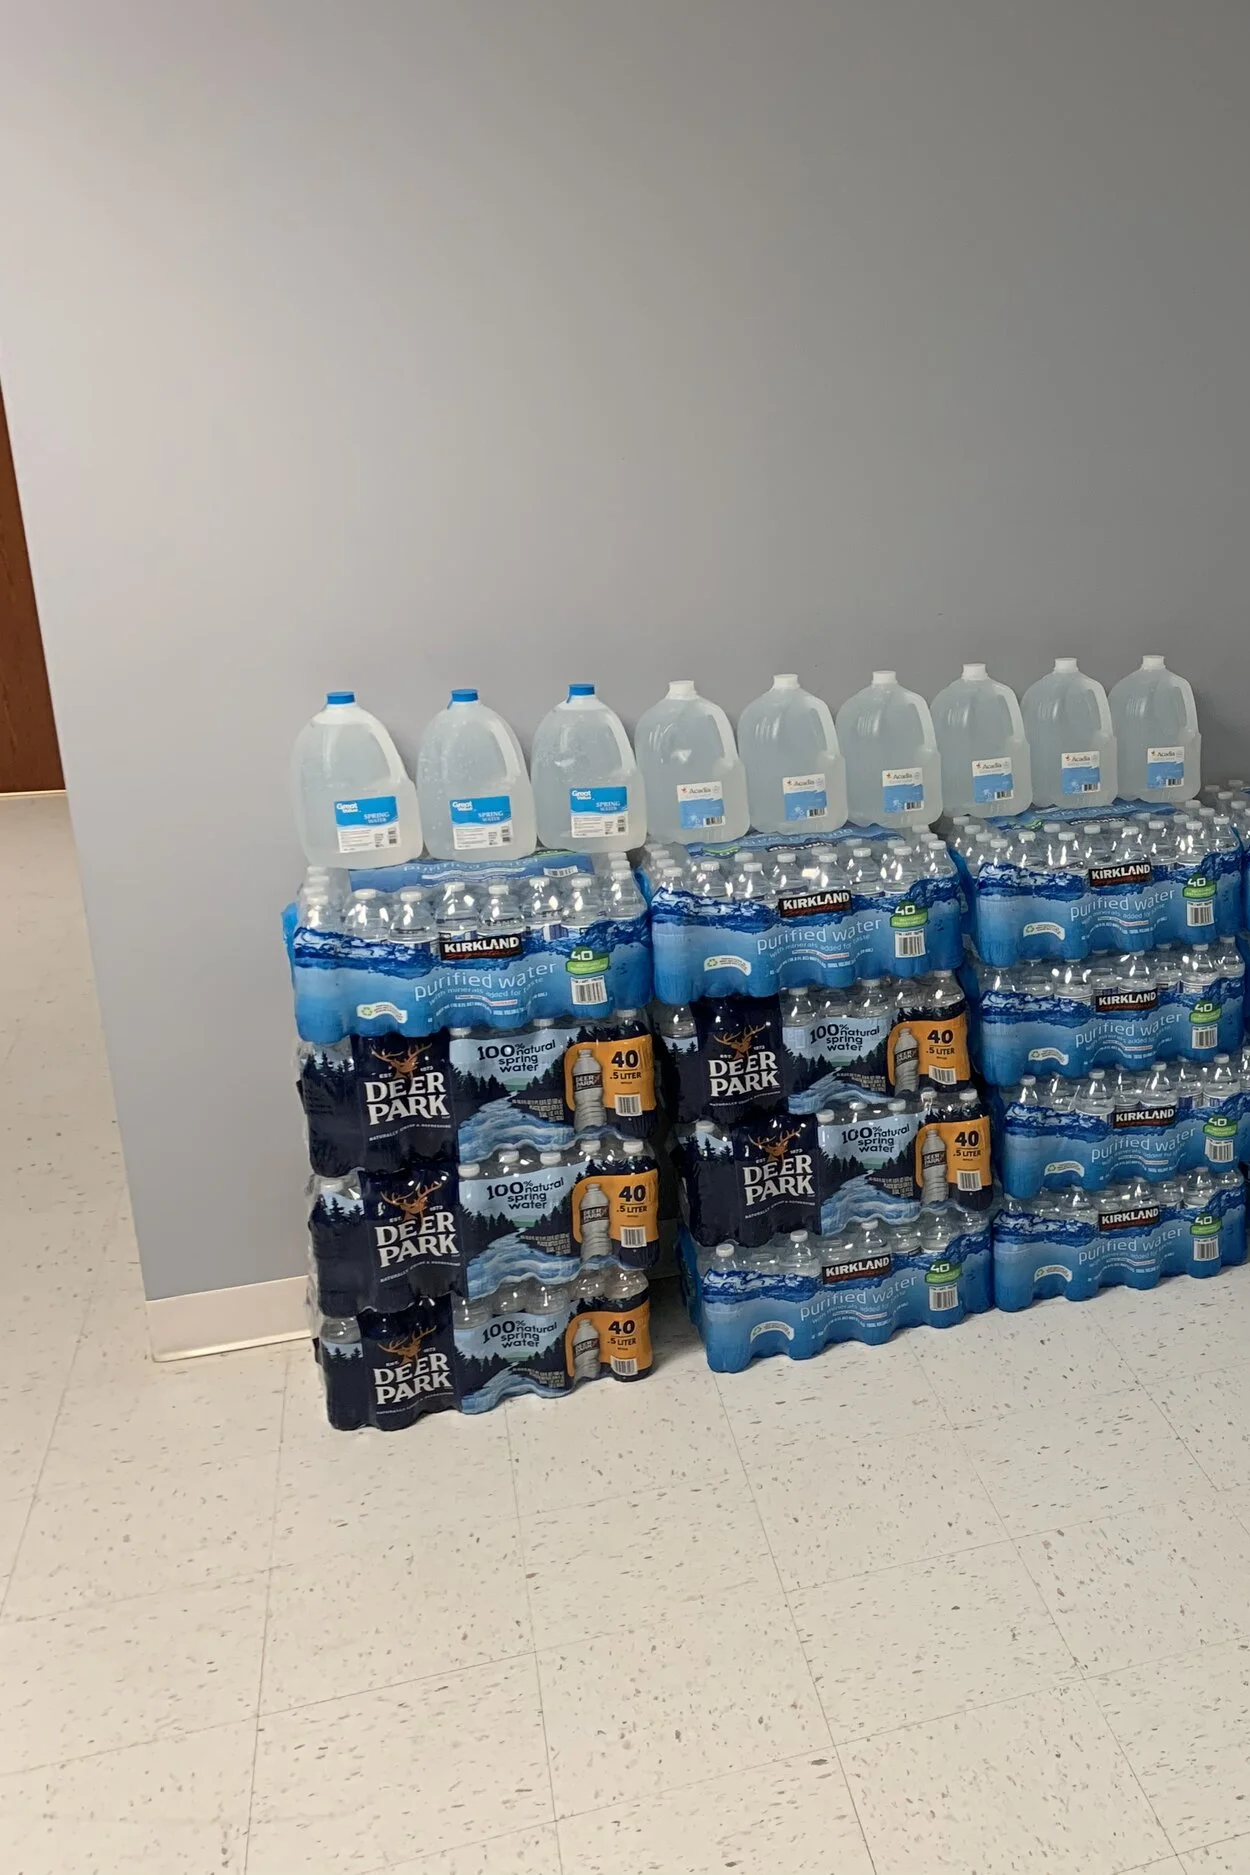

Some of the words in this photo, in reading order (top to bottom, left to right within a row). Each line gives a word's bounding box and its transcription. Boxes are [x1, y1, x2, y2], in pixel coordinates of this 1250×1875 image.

[571, 790, 592, 798] Great
[689, 786, 711, 794] Acadia
[336, 802, 358, 811] Great
[452, 801, 473, 809] Great
[595, 800, 621, 808] SPRING
[363, 811, 390, 820] SPRING
[478, 810, 504, 818] SPRING
[1092, 864, 1150, 879] KIRKLAND
[1188, 878, 1205, 887] 40
[783, 892, 849, 910] KIRKLAND
[1071, 896, 1129, 921] purified
[1134, 889, 1174, 911] water
[895, 905, 914, 915] 40
[444, 937, 519, 953] KIRKLAND
[757, 928, 827, 955] purified
[832, 920, 881, 942] water
[571, 951, 593, 961] 40
[415, 972, 492, 1001] purified
[499, 963, 556, 988] water
[1099, 992, 1156, 1005] KIRKLAND
[1195, 1004, 1212, 1012] 40
[810, 1023, 849, 1044] 100%
[840, 1026, 880, 1037] natural
[928, 1030, 953, 1044] 40
[1076, 1024, 1134, 1047] purified
[1140, 1012, 1181, 1036] water
[826, 1035, 863, 1046] spring
[827, 1042, 863, 1051] water
[478, 1044, 524, 1061] 100%
[516, 1041, 555, 1056] natural
[498, 1054, 538, 1068] spring
[500, 1062, 538, 1072] water
[612, 1051, 638, 1068] 40
[708, 1050, 778, 1076] DEER
[621, 1071, 641, 1080] LITER
[710, 1070, 780, 1096] PARK
[364, 1072, 446, 1102] DEER
[367, 1094, 450, 1125] PARK
[1116, 1109, 1174, 1122] KIRKLAND
[1209, 1118, 1226, 1126] 40
[841, 1127, 882, 1143] 100%
[874, 1125, 910, 1137] natural
[858, 1136, 894, 1147] spring
[955, 1131, 979, 1146] 40
[859, 1144, 894, 1153] water
[1092, 1138, 1150, 1162] purified
[1156, 1127, 1195, 1151] water
[742, 1156, 812, 1186] DEER
[487, 1180, 533, 1198] 100%
[524, 1179, 564, 1194] natural
[619, 1185, 646, 1202] 40
[744, 1176, 814, 1206] PARK
[508, 1192, 547, 1203] spring
[508, 1200, 547, 1210] water
[627, 1205, 647, 1213] LITER
[1102, 1208, 1158, 1224] KIRKLAND
[1194, 1215, 1212, 1224] 40
[375, 1212, 454, 1247] DEER
[380, 1234, 459, 1268] PARK
[1078, 1240, 1136, 1264] purified
[1143, 1228, 1182, 1251] water
[826, 1257, 889, 1277] KIRKLAND
[931, 1263, 949, 1273] 40
[800, 1291, 866, 1320] purified
[872, 1276, 916, 1303] water
[483, 1321, 526, 1344] 100%
[516, 1322, 557, 1333] natural
[608, 1320, 635, 1335] 40
[501, 1333, 540, 1343] spring
[501, 1340, 540, 1349] water
[618, 1337, 637, 1345] LITER
[373, 1353, 449, 1386] DEER
[376, 1374, 453, 1404] PARK
